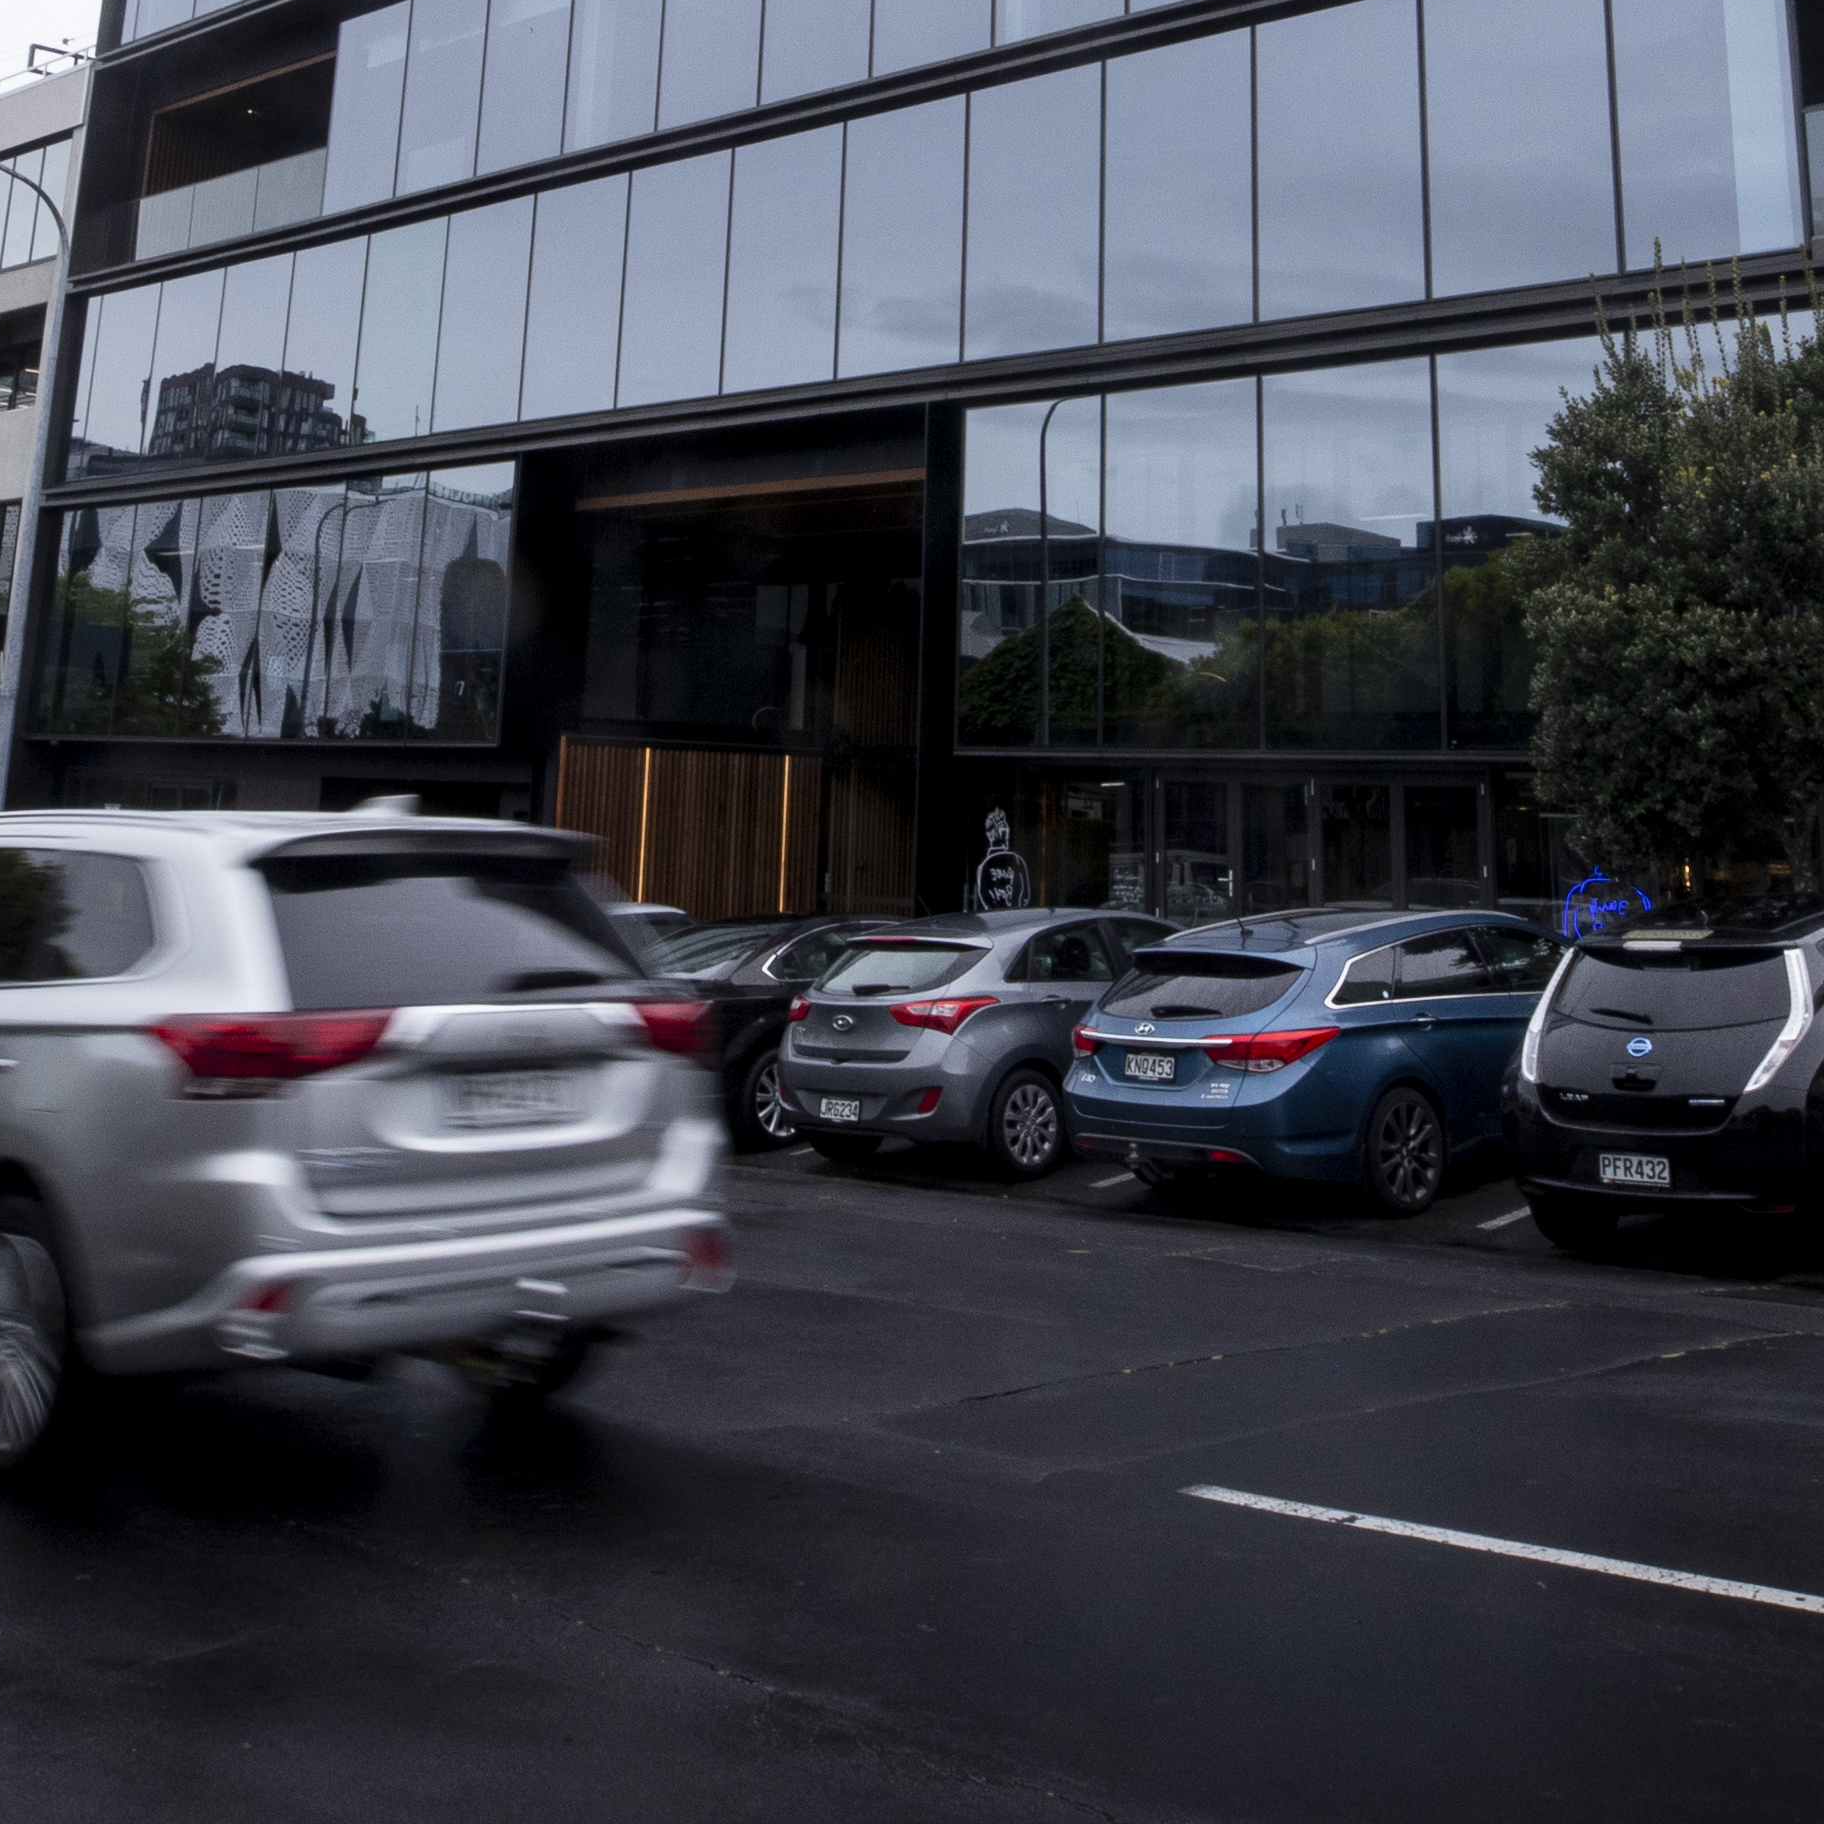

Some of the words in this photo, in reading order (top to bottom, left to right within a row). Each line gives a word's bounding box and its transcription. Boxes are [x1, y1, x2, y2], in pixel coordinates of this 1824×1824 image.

[1126, 1057, 1174, 1078] KNQ453
[821, 1100, 859, 1120] JRG234
[1600, 1155, 1669, 1181] PFR432
